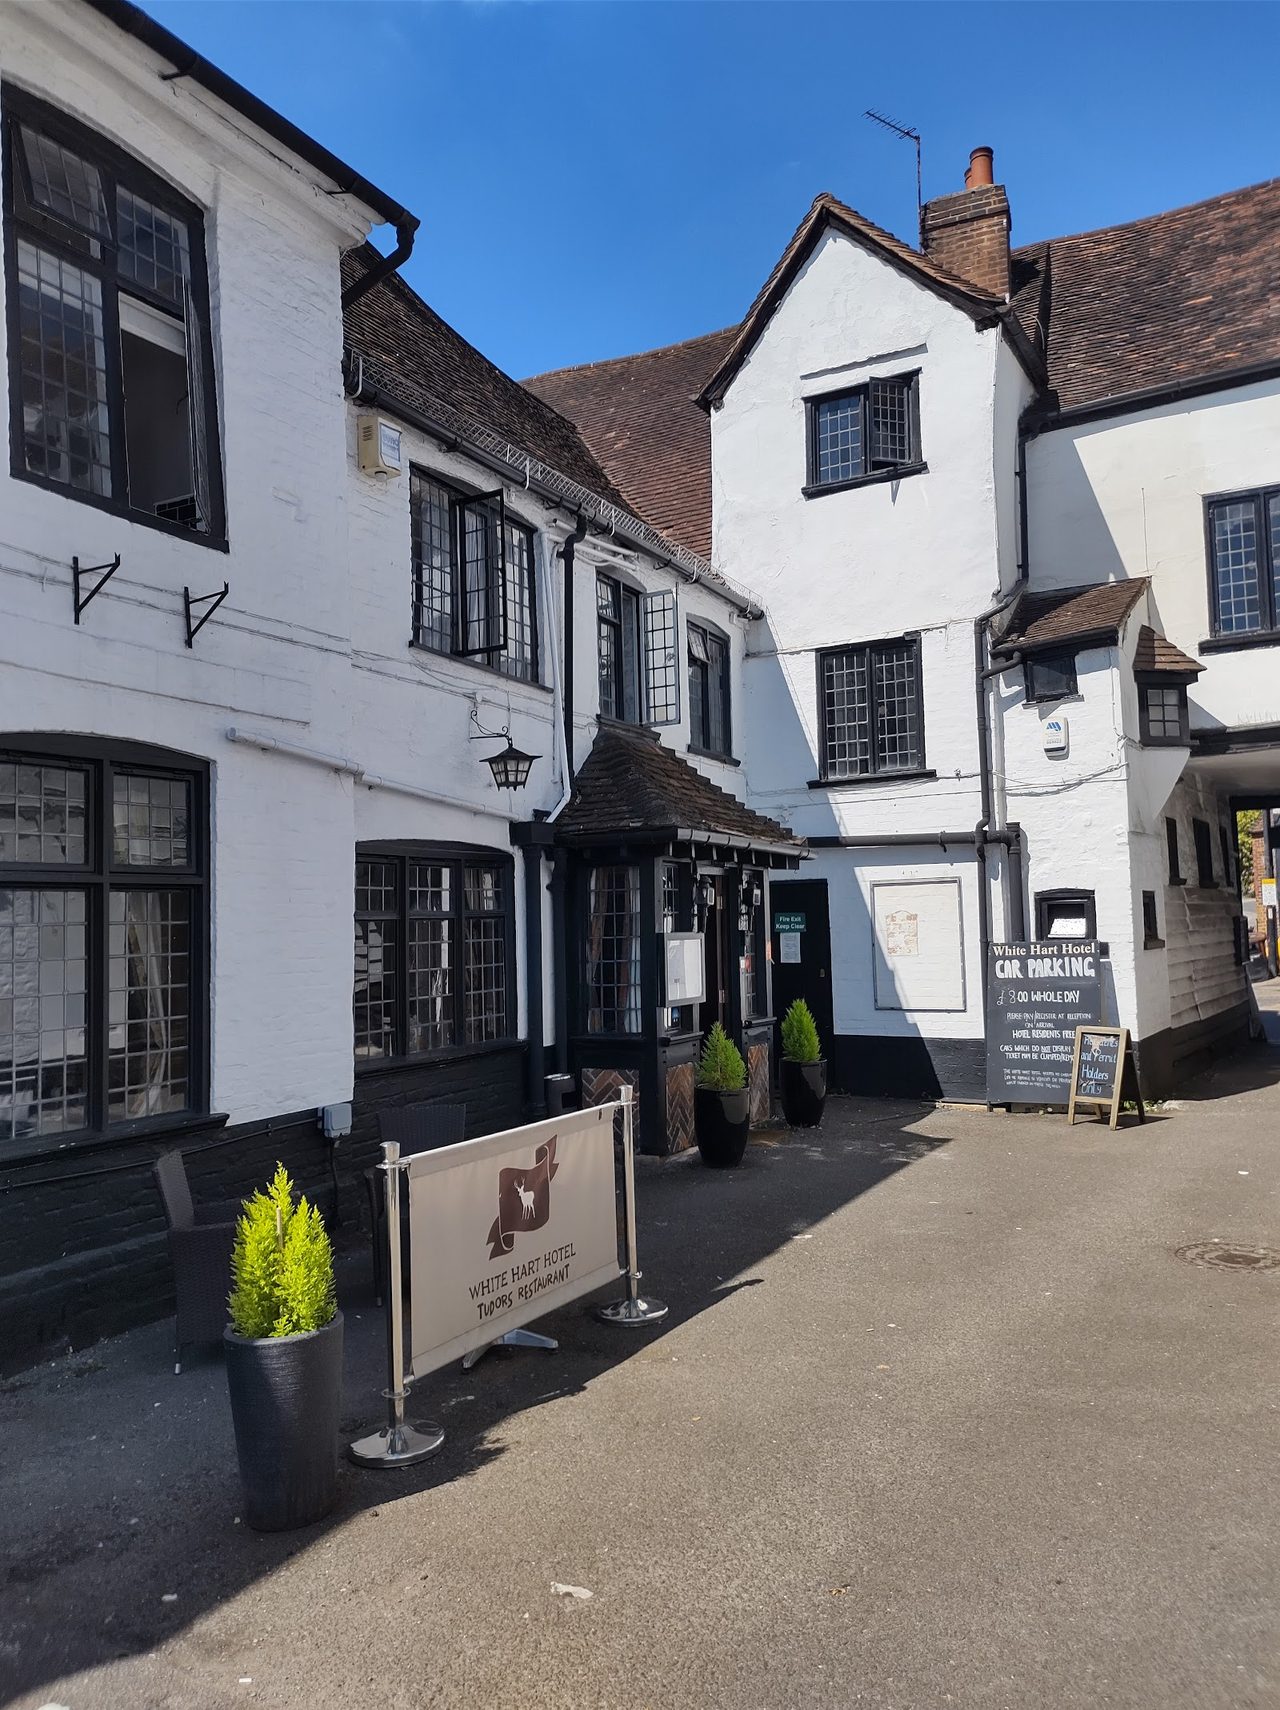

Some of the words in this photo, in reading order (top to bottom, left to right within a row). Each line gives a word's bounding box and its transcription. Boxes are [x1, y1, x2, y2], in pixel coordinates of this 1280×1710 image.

[993, 945, 1027, 956] White
[1030, 944, 1058, 955] Hart
[1061, 942, 1095, 954] Hotel
[995, 959, 1024, 978] CAR
[1027, 957, 1095, 978] PARKING
[1031, 990, 1062, 1003] WHOLE
[1064, 990, 1080, 1003] DAY
[1006, 1012, 1022, 1020] PLEASE
[1012, 1030, 1030, 1039] HOTEL
[1032, 1030, 1061, 1039] RESIDENTS
[1062, 1030, 1076, 1039] FREE
[1081, 1051, 1091, 1061] and
[1081, 1064, 1109, 1080] Holders
[469, 1271, 508, 1300] WHITE
[511, 1257, 541, 1283] HART
[543, 1242, 576, 1268] HOTEL
[477, 1291, 513, 1320] TUDORS
[517, 1263, 570, 1300] RESTAURANT
